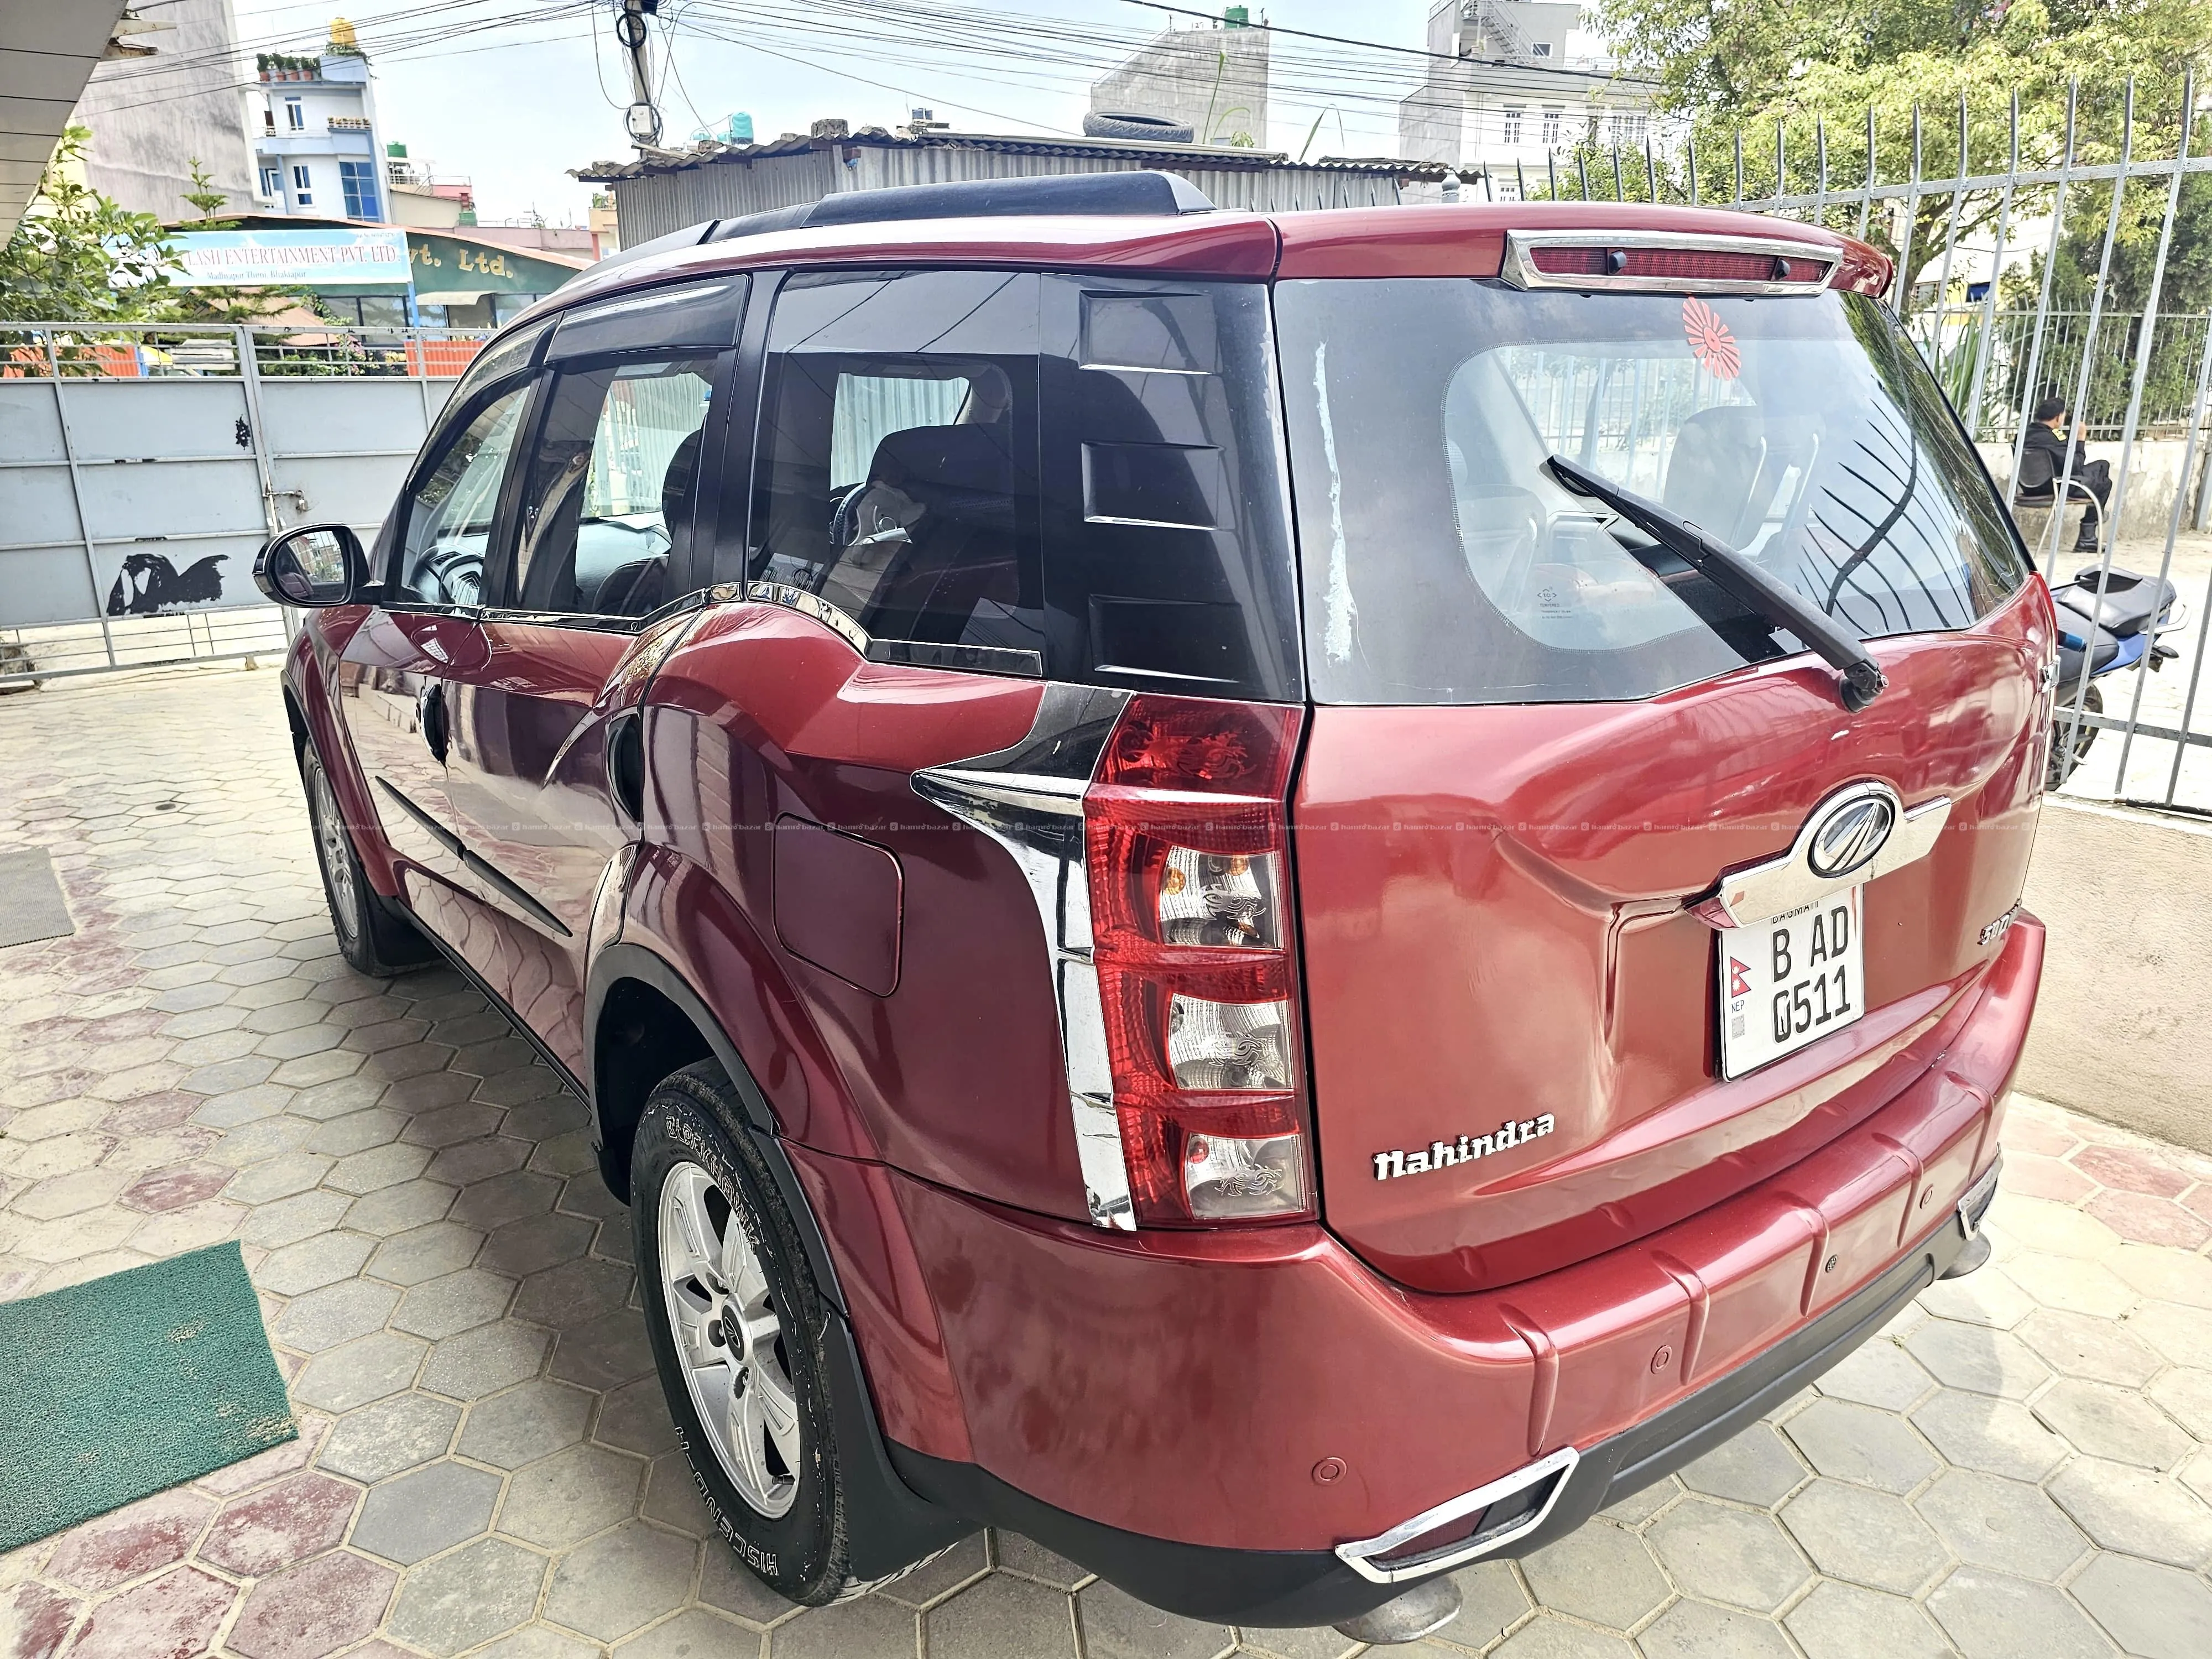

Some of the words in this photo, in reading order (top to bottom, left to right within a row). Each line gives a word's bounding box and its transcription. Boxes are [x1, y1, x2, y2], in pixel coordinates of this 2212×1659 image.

[180, 249, 221, 265] LASH
[225, 247, 336, 265] ENTERTAINMENT
[341, 246, 367, 263] PVT.
[372, 246, 400, 262] LTD.
[458, 249, 514, 278] Ltd.
[270, 270, 306, 280] Bhaktapur
[1773, 928, 1792, 983] B
[1810, 905, 1849, 967] AD
[1731, 1000, 1744, 1013] NEP
[1773, 965, 1851, 1044] 0511
[1373, 1112, 1554, 1181] Mahindra
